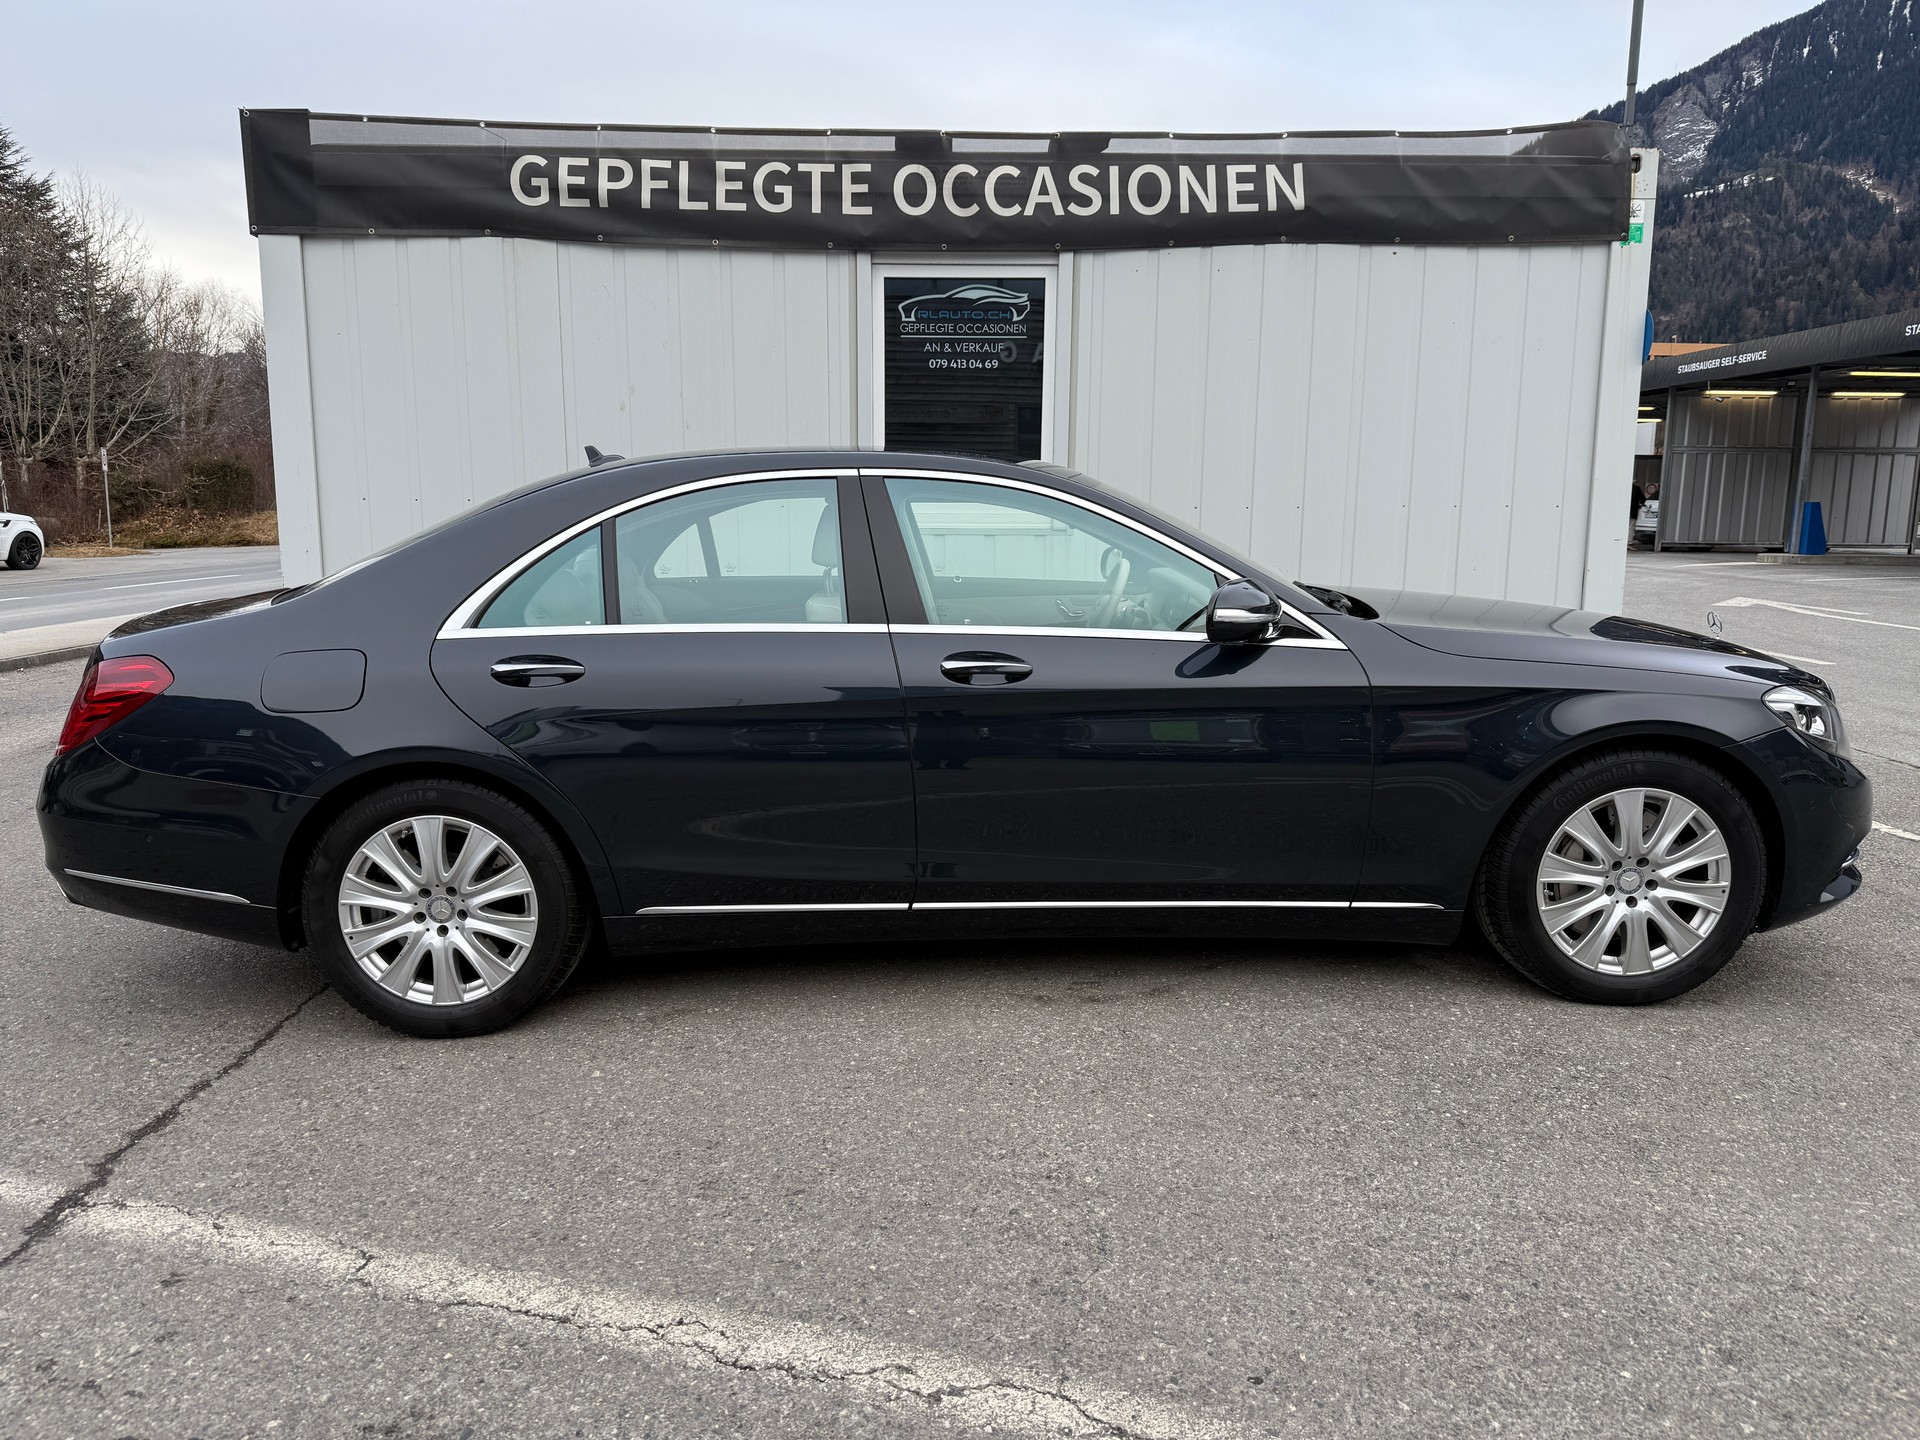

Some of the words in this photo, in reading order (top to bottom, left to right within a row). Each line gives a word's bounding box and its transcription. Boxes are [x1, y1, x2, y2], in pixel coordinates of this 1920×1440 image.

[509, 154, 873, 215] GEPFLEGTE
[893, 162, 1306, 217] OCCASIONEN
[917, 310, 1010, 319] RLAUTO.CH
[900, 323, 954, 333] GEPFLEGTE
[956, 323, 1027, 334] OCCASIONEN
[923, 342, 941, 353] AN
[943, 342, 952, 353] &
[955, 342, 1004, 353] VERKAUF
[929, 359, 948, 369] 079
[950, 359, 966, 369] 413
[968, 359, 983, 369] 04
[984, 359, 999, 369] 69
[1677, 358, 1720, 374] STAUBSAUGER
[1720, 350, 1767, 367] SELF-SERVICE
